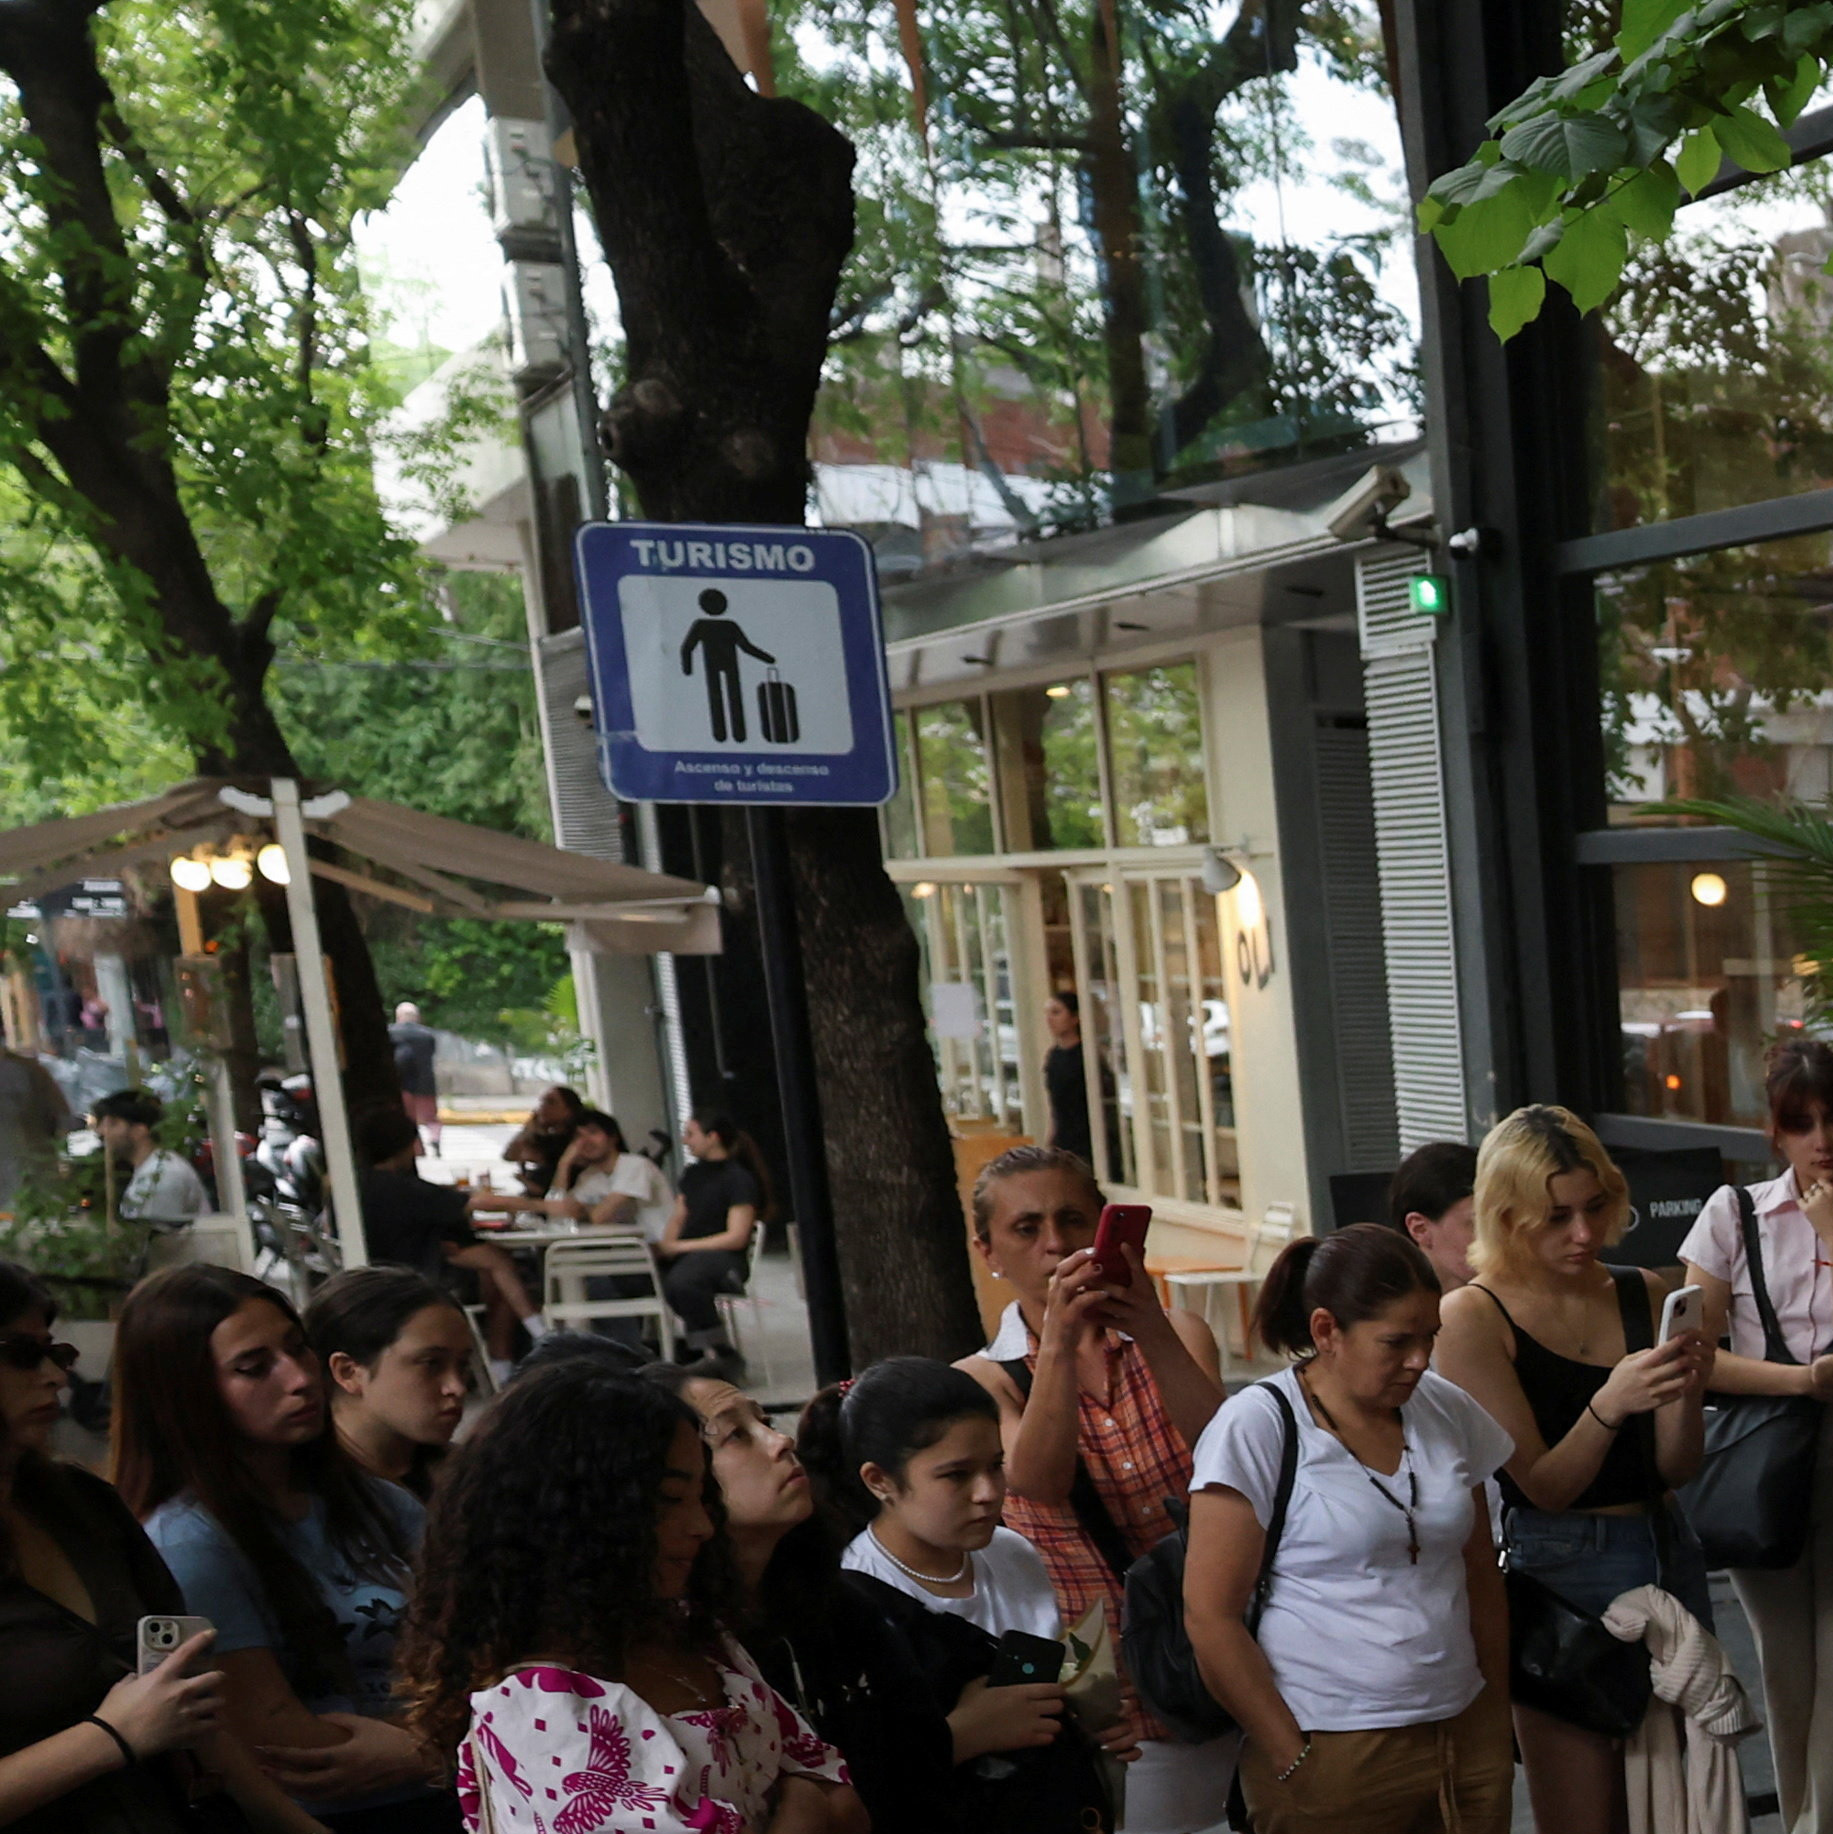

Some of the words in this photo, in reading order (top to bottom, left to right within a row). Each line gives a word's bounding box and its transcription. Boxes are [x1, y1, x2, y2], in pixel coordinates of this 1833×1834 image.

[630, 539, 816, 572] TURISMO
[674, 760, 741, 774] Ascenso
[743, 763, 753, 777] y
[714, 779, 733, 792] de
[1649, 1198, 1703, 1218] PARKING
